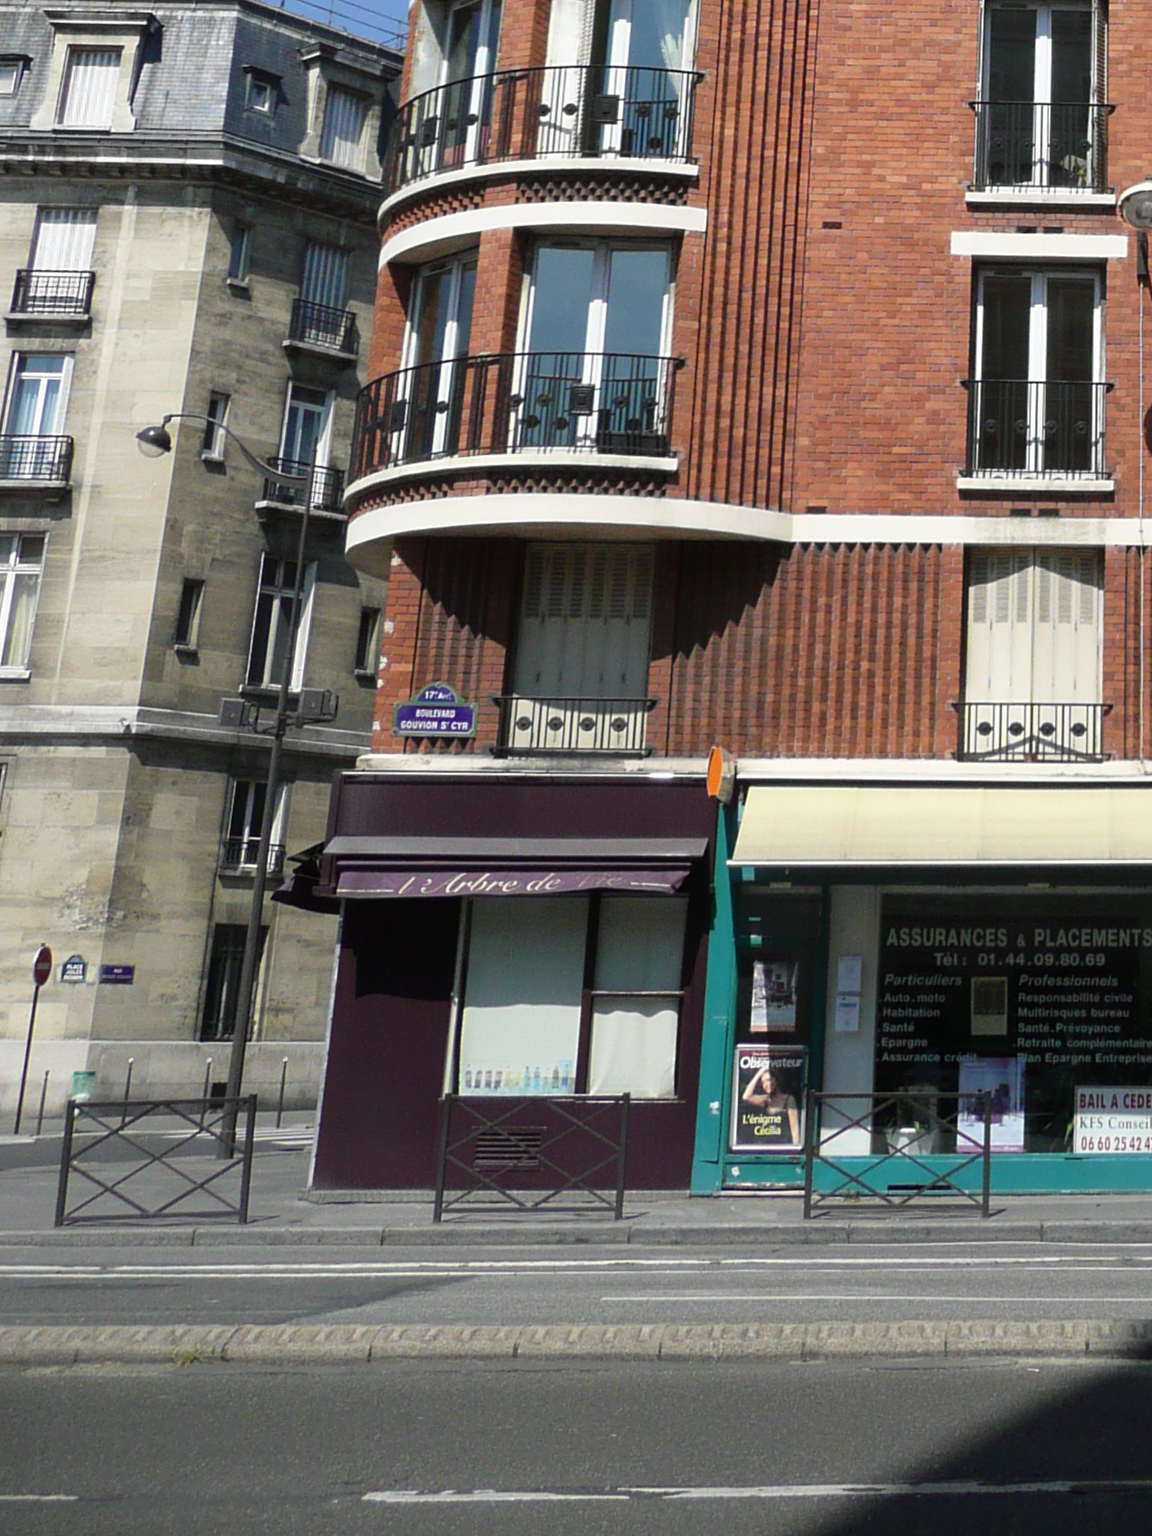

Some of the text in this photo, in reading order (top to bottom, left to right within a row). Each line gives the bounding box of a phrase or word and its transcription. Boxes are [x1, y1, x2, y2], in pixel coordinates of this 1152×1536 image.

[415, 709, 456, 718] BOULEVARD
[400, 720, 438, 729] GOUVION
[451, 721, 469, 730] CYR
[526, 873, 562, 891] de
[886, 928, 1152, 947] ASSURANCES & PLACEMENTS
[977, 953, 1106, 966] 01.44.09.80.69
[884, 974, 962, 986] Particuliers
[1018, 974, 1119, 987] Professionnels
[1018, 992, 1133, 1005] Responsabilité civile
[882, 1007, 940, 1017] Habitation
[1018, 1007, 1087, 1019] Multirisques
[1091, 1007, 1130, 1017] bureau
[882, 1022, 915, 1033] Santé
[881, 1037, 929, 1050] Epargne
[1017, 1037, 1152, 1050] Retraite complémentaire
[740, 1056, 803, 1069] Observateur
[881, 1051, 977, 1062] Assurance crédit
[1045, 1052, 1090, 1065] Epargne
[1095, 1052, 1152, 1065] Entreprise
[1079, 1093, 1106, 1109] BAIL
[1110, 1093, 1119, 1109] A
[742, 1114, 782, 1125] L'énigme
[1079, 1116, 1103, 1129] KFS
[753, 1124, 782, 1135] Cécilia
[1081, 1135, 1095, 1151] 06
[1097, 1135, 1111, 1151] 60
[1114, 1135, 1127, 1151] 25
[1129, 1135, 1142, 1151] 42
